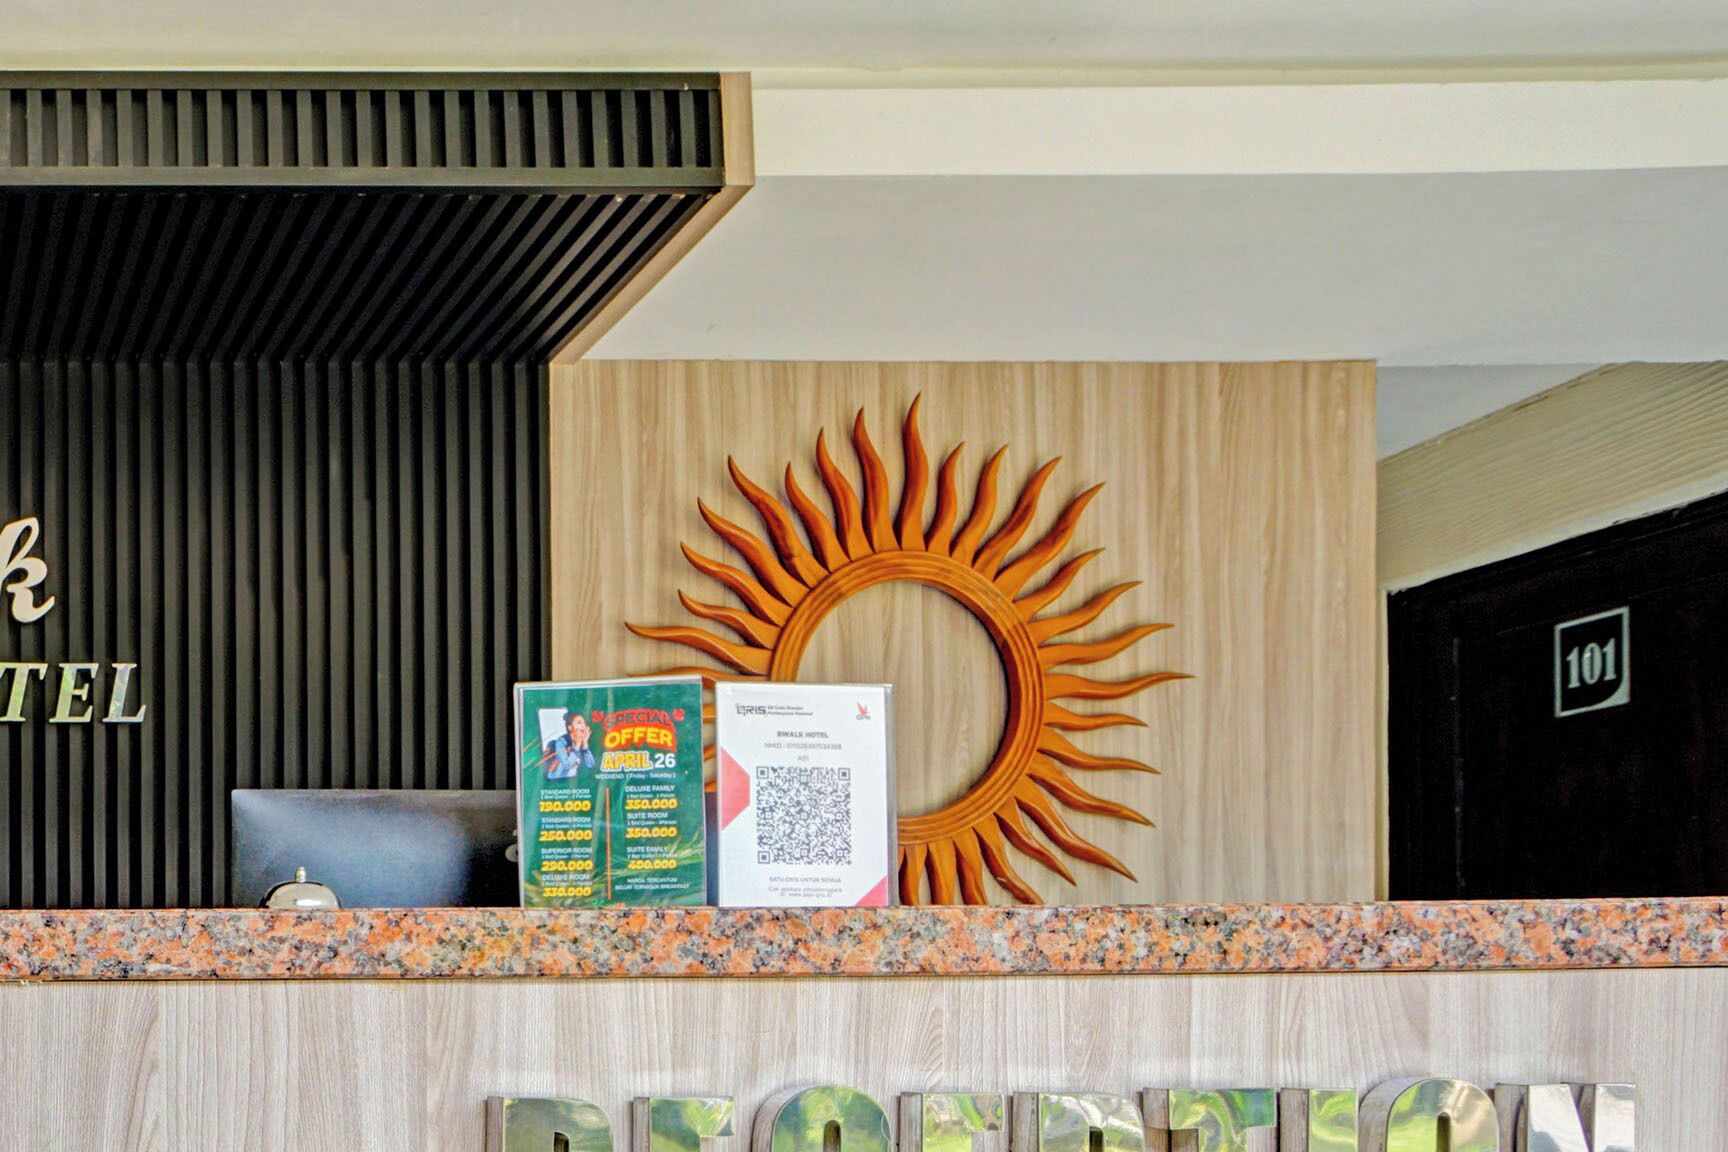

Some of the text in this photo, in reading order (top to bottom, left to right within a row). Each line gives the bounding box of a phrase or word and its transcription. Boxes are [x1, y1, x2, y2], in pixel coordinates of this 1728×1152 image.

[1566, 637, 1617, 689] 101
[736, 705, 767, 716] QRIS
[605, 710, 672, 729] SPECIAL
[605, 727, 673, 749] OFFER
[777, 730, 804, 738] BWALK
[601, 752, 676, 771] APRIL 26
[539, 800, 592, 812] 190.000
[625, 798, 677, 810] 350.000
[539, 829, 593, 841] 250.000
[625, 827, 677, 838] 350.000
[541, 860, 593, 871] 290.000
[628, 859, 677, 870] 400.000
[543, 886, 592, 897] 330.000
